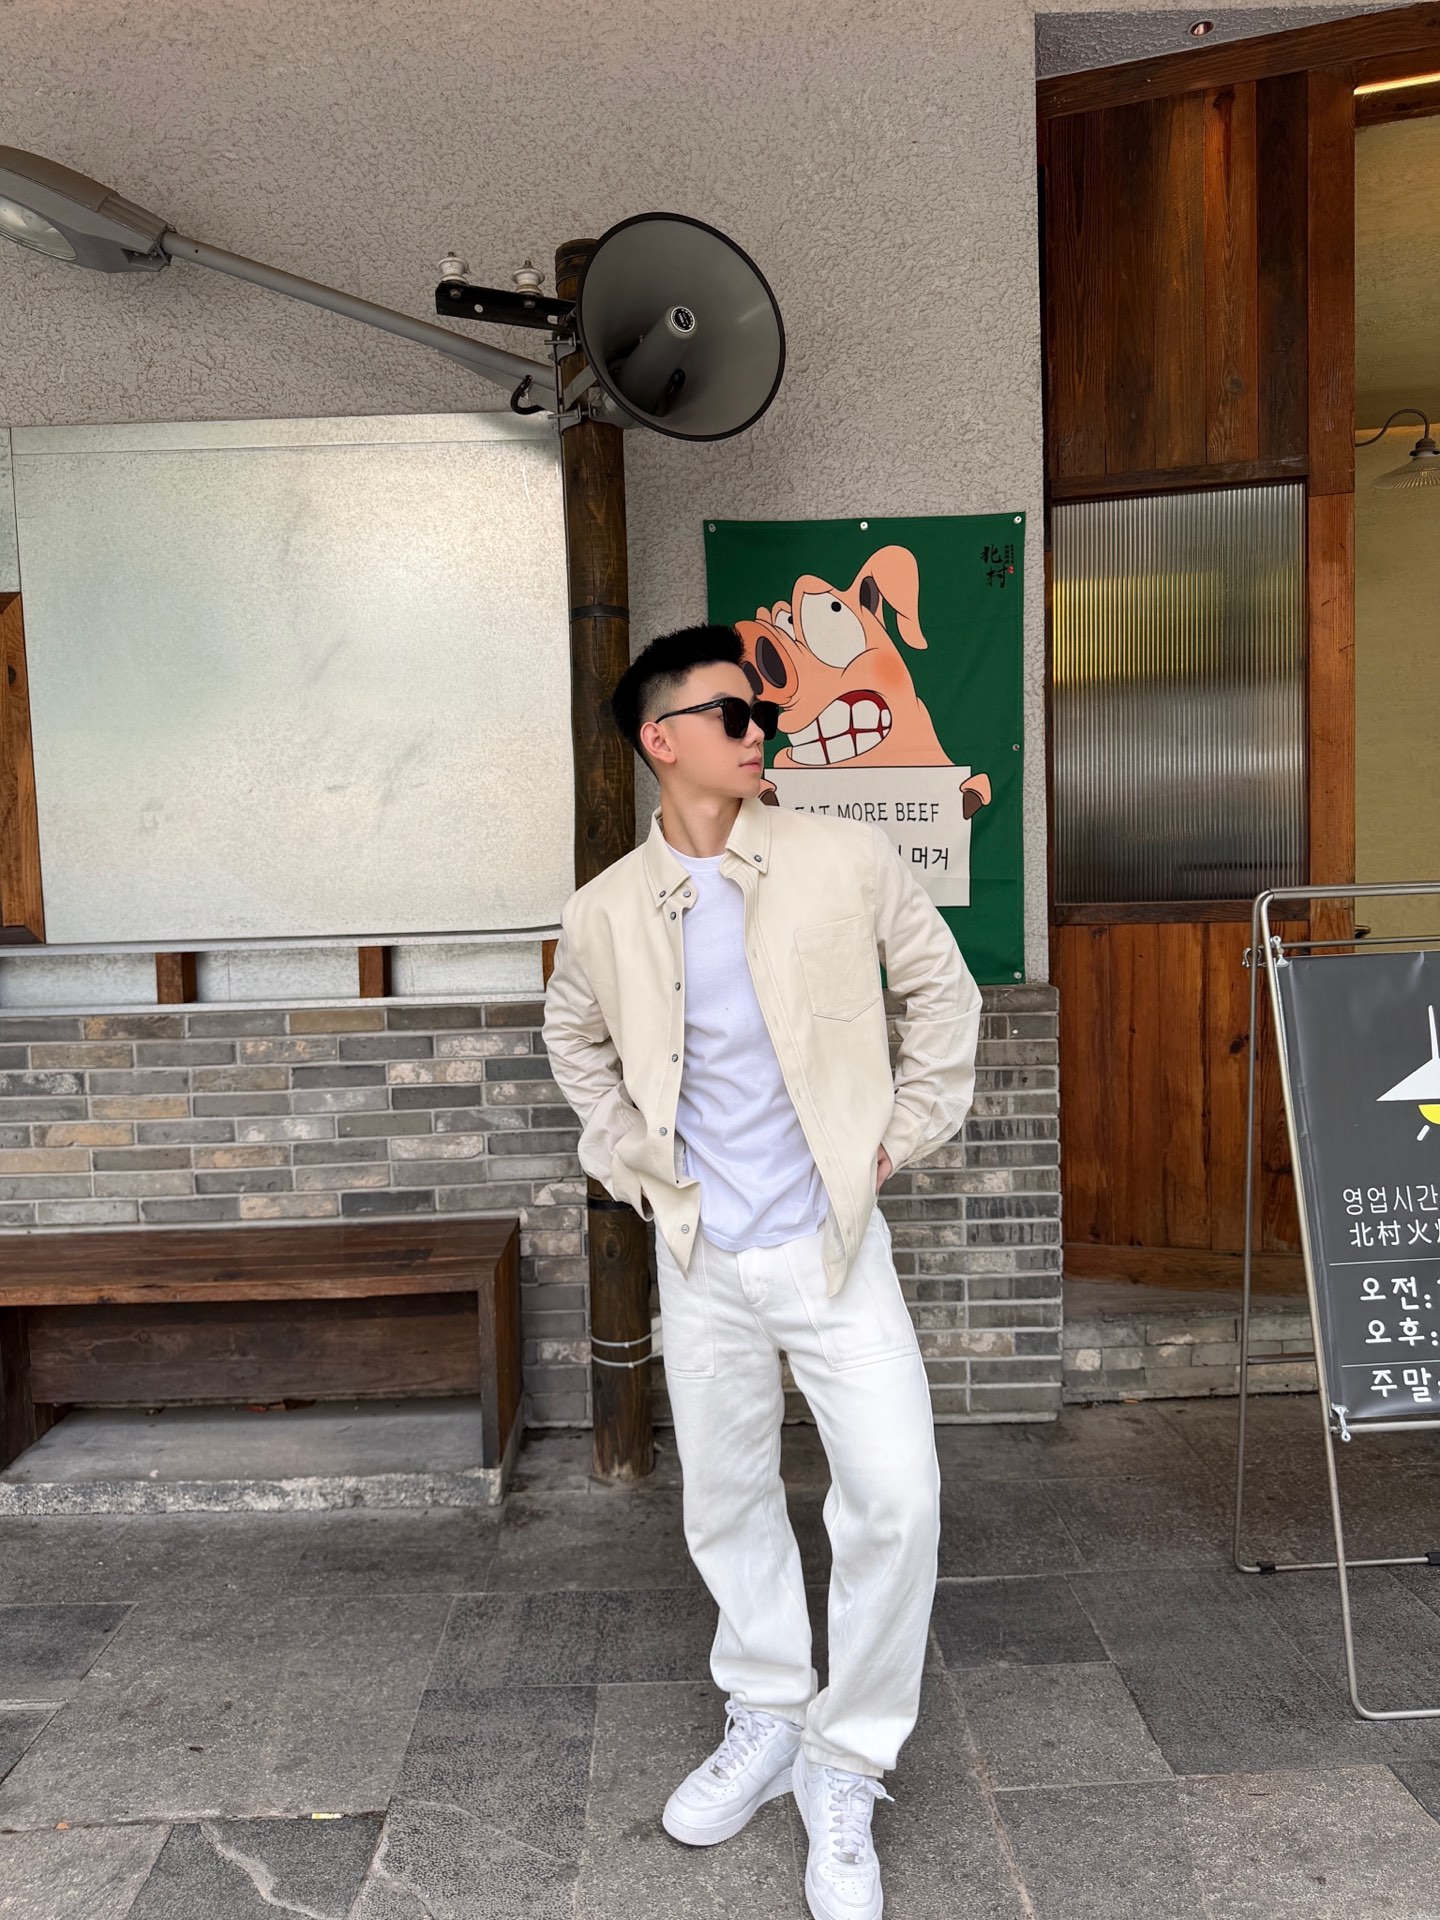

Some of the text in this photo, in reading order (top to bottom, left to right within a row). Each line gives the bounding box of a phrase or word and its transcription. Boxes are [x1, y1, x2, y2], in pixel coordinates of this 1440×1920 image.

[837, 803, 888, 823] MORE
[895, 802, 940, 823] BEEF
[911, 846, 949, 871] 머거
[1343, 1184, 1439, 1216] 영업시간
[1349, 1218, 1440, 1248] 北村火
[1360, 1275, 1440, 1310] 오전:
[1370, 1367, 1440, 1403] 주말
